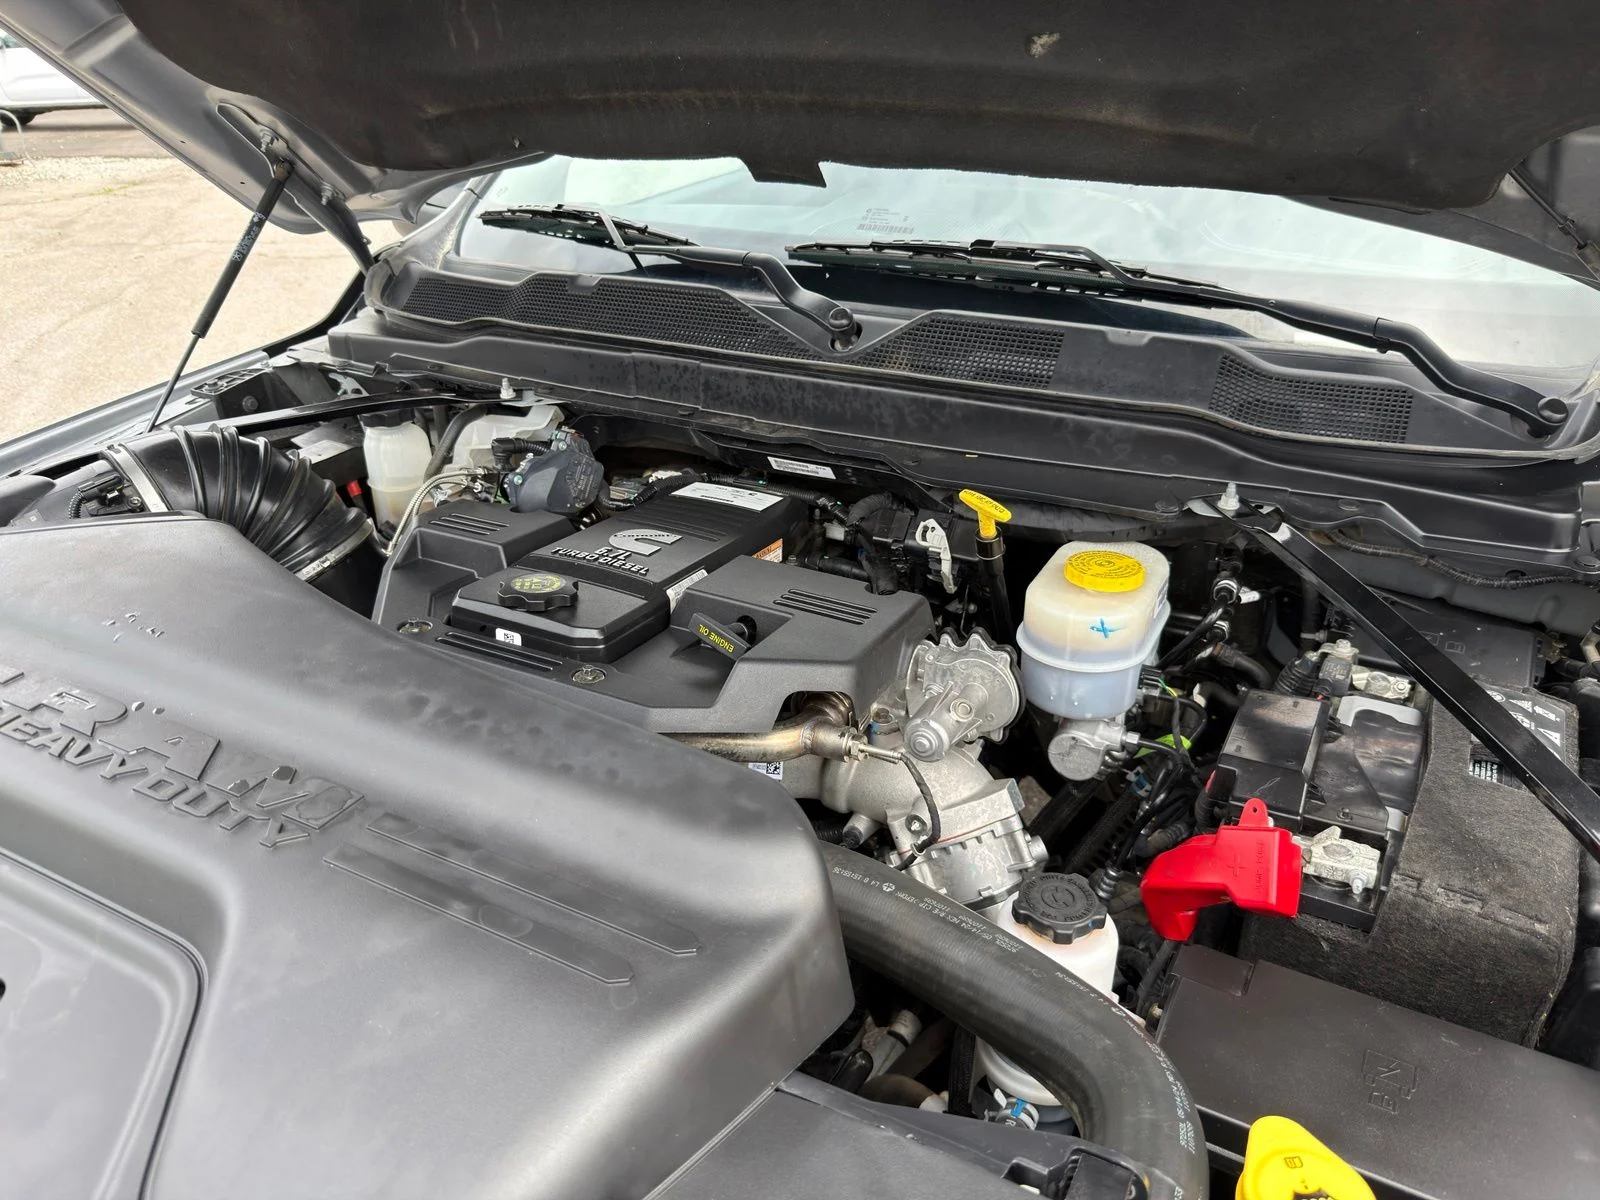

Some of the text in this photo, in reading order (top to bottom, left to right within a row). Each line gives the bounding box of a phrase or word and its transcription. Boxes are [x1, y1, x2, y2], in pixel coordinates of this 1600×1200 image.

[551, 547, 649, 576] TURBO DIESEL
[594, 546, 632, 560] 6.7L
[697, 624, 735, 653] ENGINE OIL
[3, 672, 366, 831] RAM
[132, 771, 310, 848] DUTY
